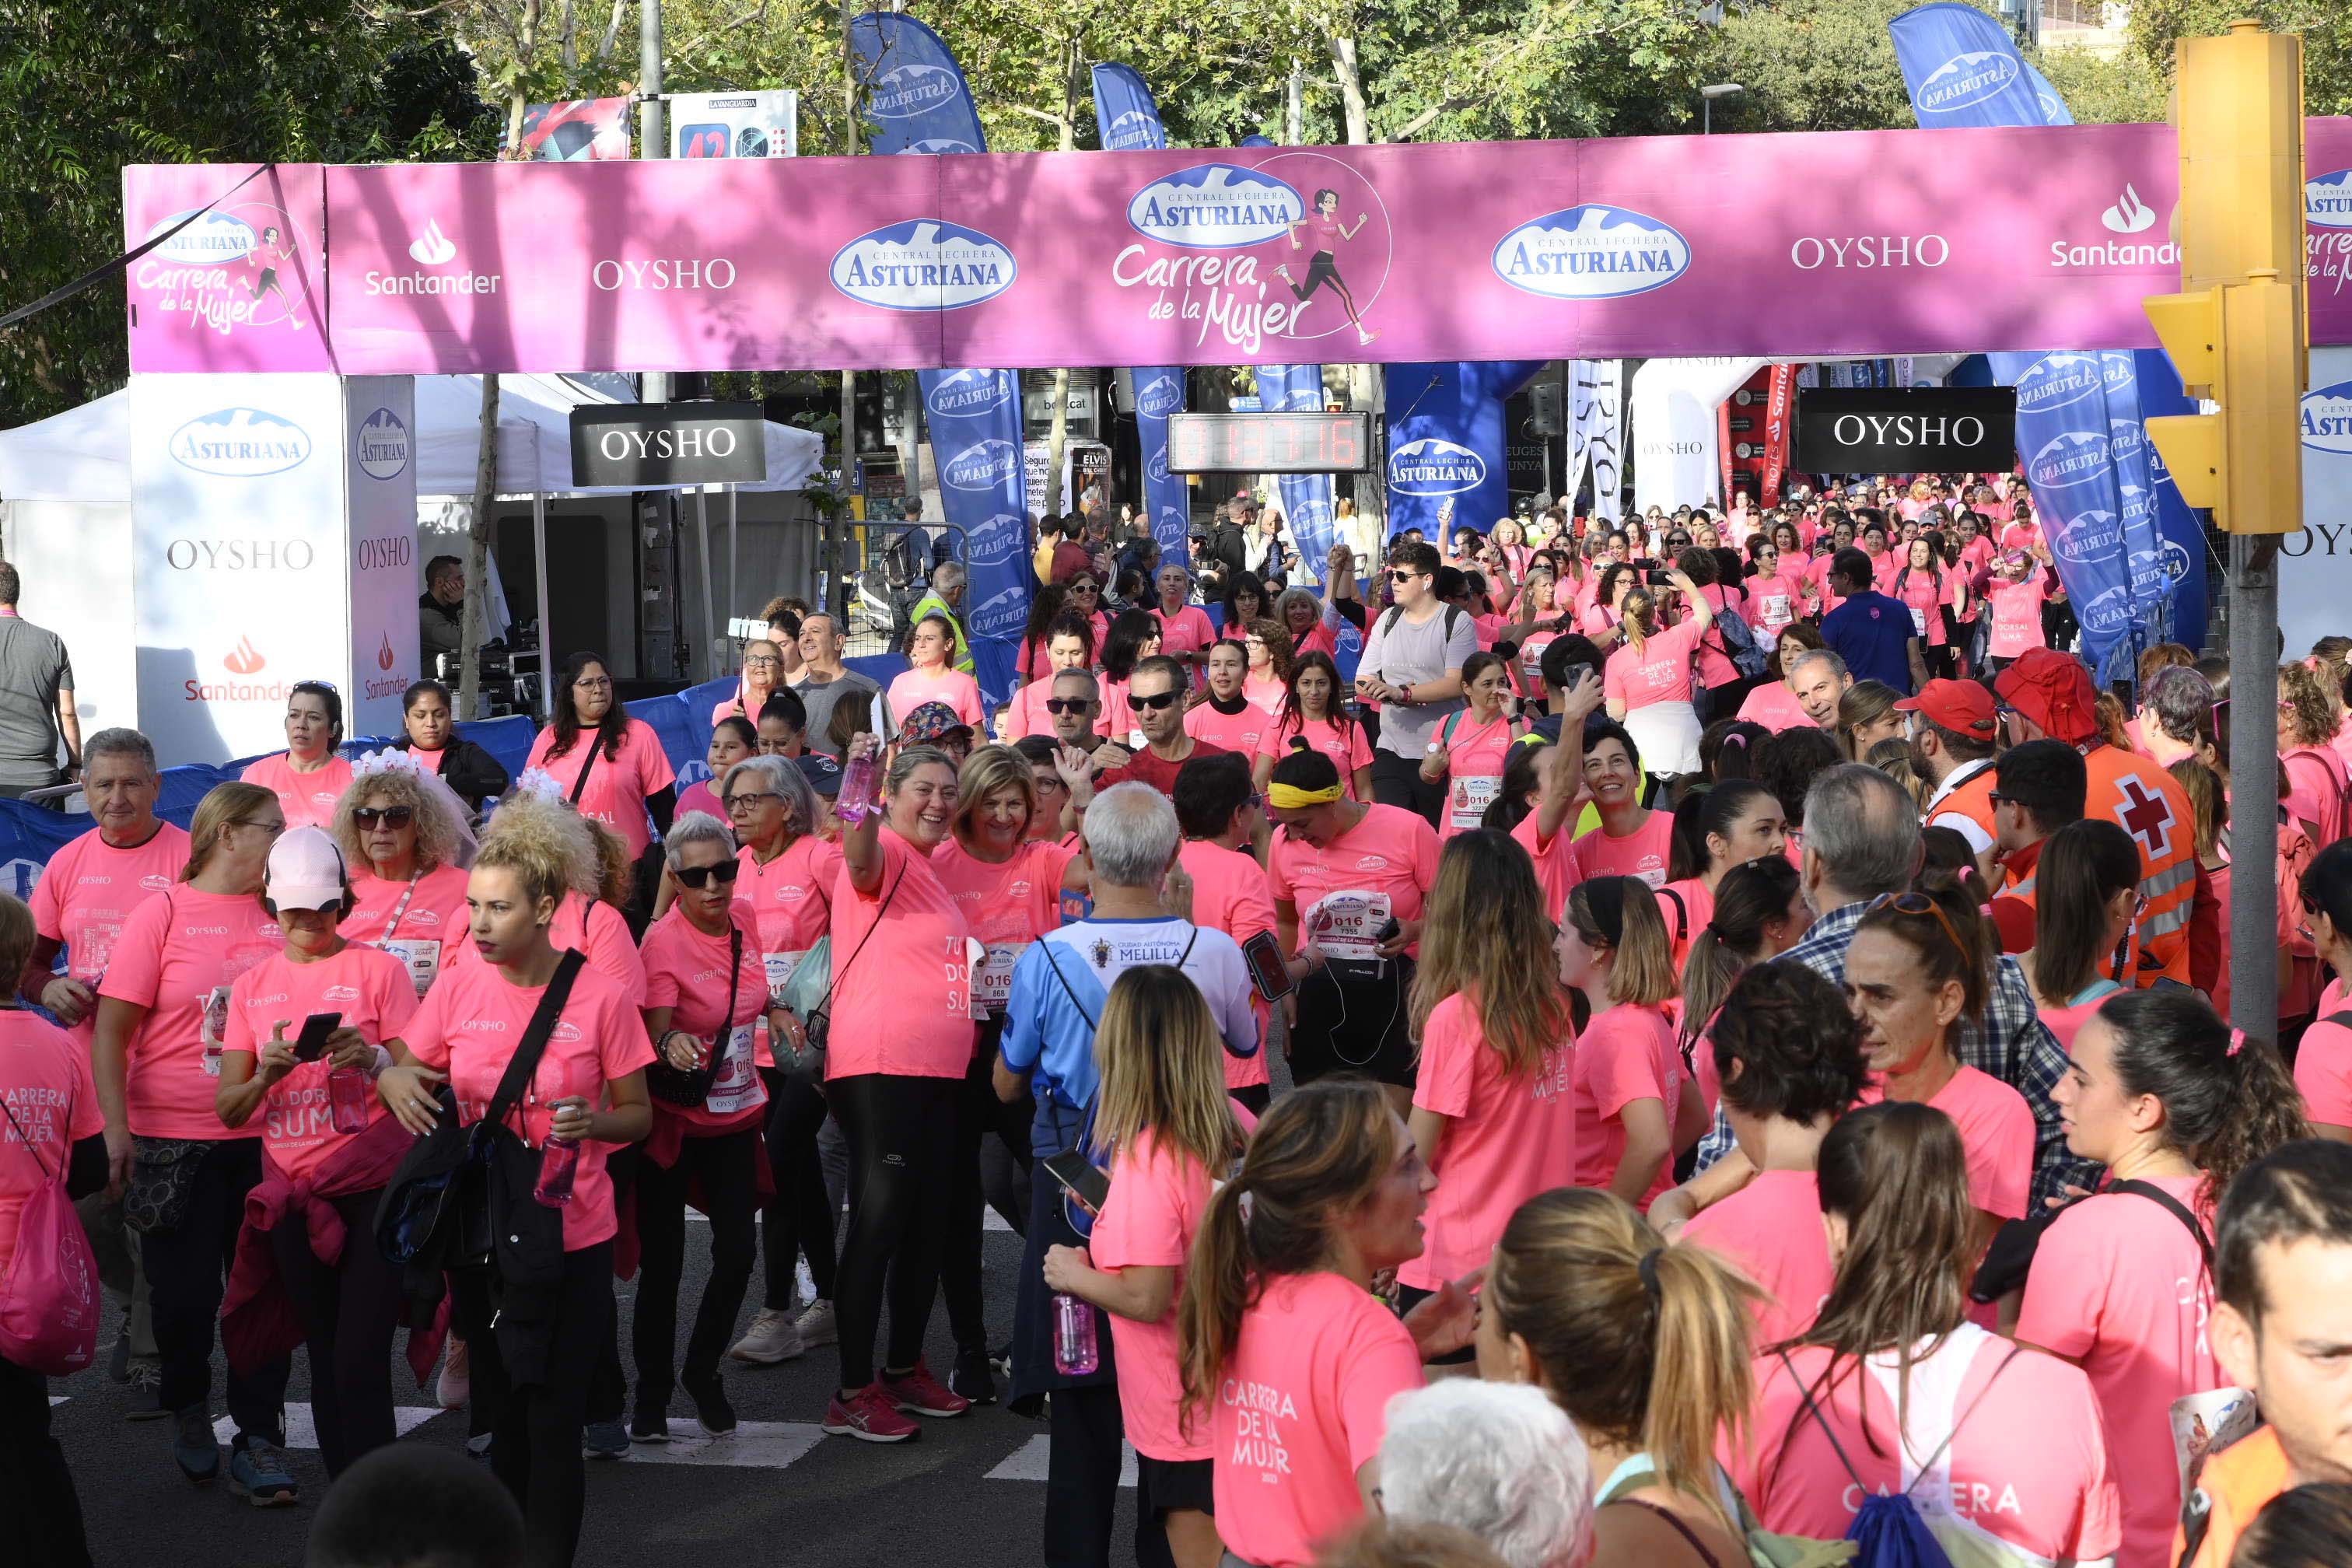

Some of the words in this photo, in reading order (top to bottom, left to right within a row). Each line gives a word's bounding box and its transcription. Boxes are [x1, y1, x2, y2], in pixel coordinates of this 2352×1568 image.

[717, 99, 756, 107] VANGUARDIA
[1229, 192, 1286, 201] LECHERA
[1141, 196, 1290, 227] ASTURIANA
[1538, 237, 1599, 247] CENTRAL
[1605, 236, 1669, 246] LECHERA
[1791, 235, 1949, 269] OYSHO
[873, 251, 932, 260] CENTRAL
[937, 250, 996, 259] LECHERA
[1112, 243, 1258, 287] Carrera
[1507, 241, 1675, 275] ASTURIANA
[137, 261, 227, 289] Carrera
[593, 258, 736, 291] OYSHO
[845, 254, 1002, 287] ASTURIANA
[2323, 256, 2337, 277] la
[366, 271, 501, 296] Santander
[159, 292, 177, 310] de
[180, 292, 192, 310] la
[190, 288, 262, 334] Mujer
[1148, 289, 1175, 320] de
[1181, 288, 1200, 319] la
[1196, 282, 1312, 355] Mujer
[1834, 415, 1984, 446] OYSHO
[180, 435, 302, 460] ASTURIANA
[360, 436, 406, 462] ASTURIANA
[600, 427, 737, 460] OYSHO
[1083, 455, 1107, 465] ELVIS
[1391, 462, 1479, 483] ASTURIANA
[166, 539, 313, 570] OYSHO
[359, 536, 410, 570] OYSHO
[1638, 659, 1678, 675] CARRERA
[1661, 667, 1672, 676] LA
[365, 677, 409, 702] Santander
[1648, 673, 1677, 688] MUJER
[78, 876, 111, 885] OYSHO
[187, 926, 228, 936] OYSHO
[1335, 916, 1363, 926] 016
[946, 936, 961, 956] TU
[1119, 947, 1182, 961] MELILLA
[985, 975, 1011, 986] 016
[247, 992, 288, 1007] OYSHO
[461, 1020, 506, 1032] OYSHO
[9, 1106, 30, 1125] DE
[33, 1106, 53, 1125] LA
[5, 1125, 54, 1143] MUJER
[1223, 1378, 1298, 1421] CARRERA
[1238, 1409, 1262, 1438] DE
[1265, 1414, 1282, 1445] LA
